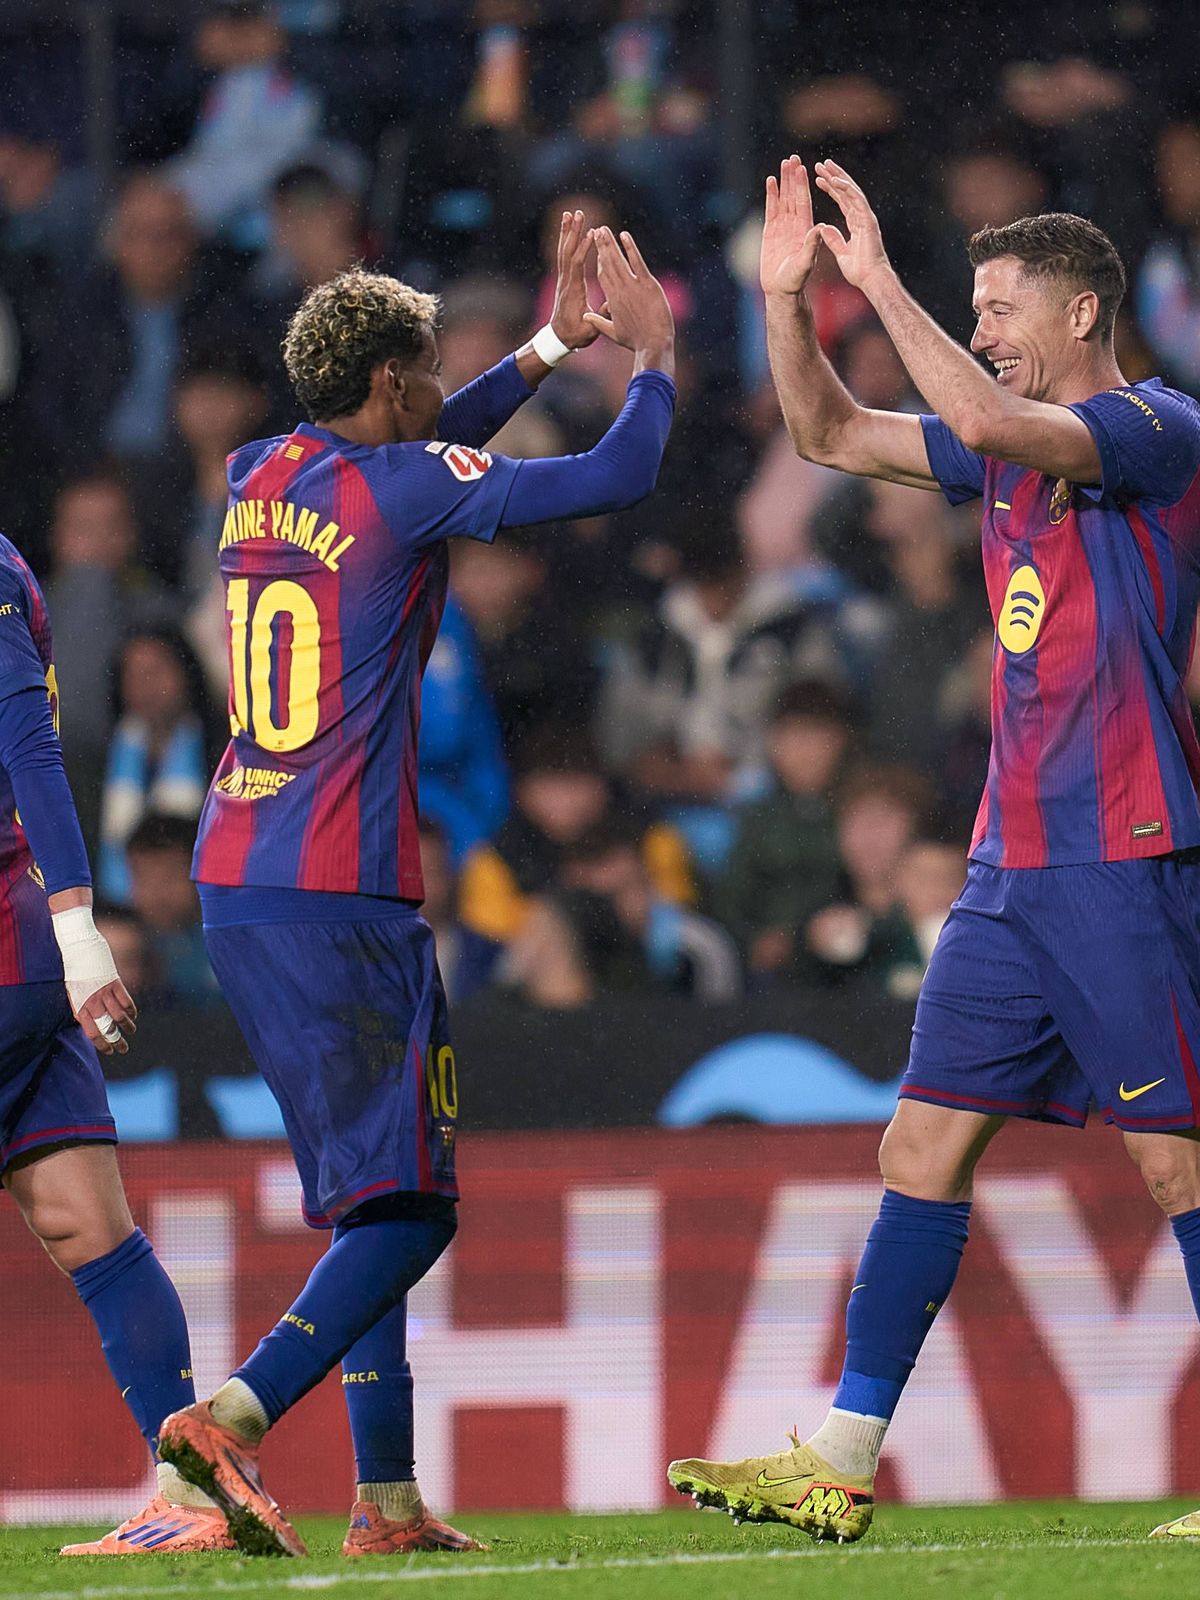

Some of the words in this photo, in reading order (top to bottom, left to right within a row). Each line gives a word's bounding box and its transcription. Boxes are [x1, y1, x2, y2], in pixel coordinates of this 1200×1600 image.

[219, 499, 266, 552] MINE
[270, 500, 355, 572] YAMAL
[226, 578, 321, 752] 10
[240, 784, 279, 800] ACN
[341, 1371, 379, 1385] ARÇA
